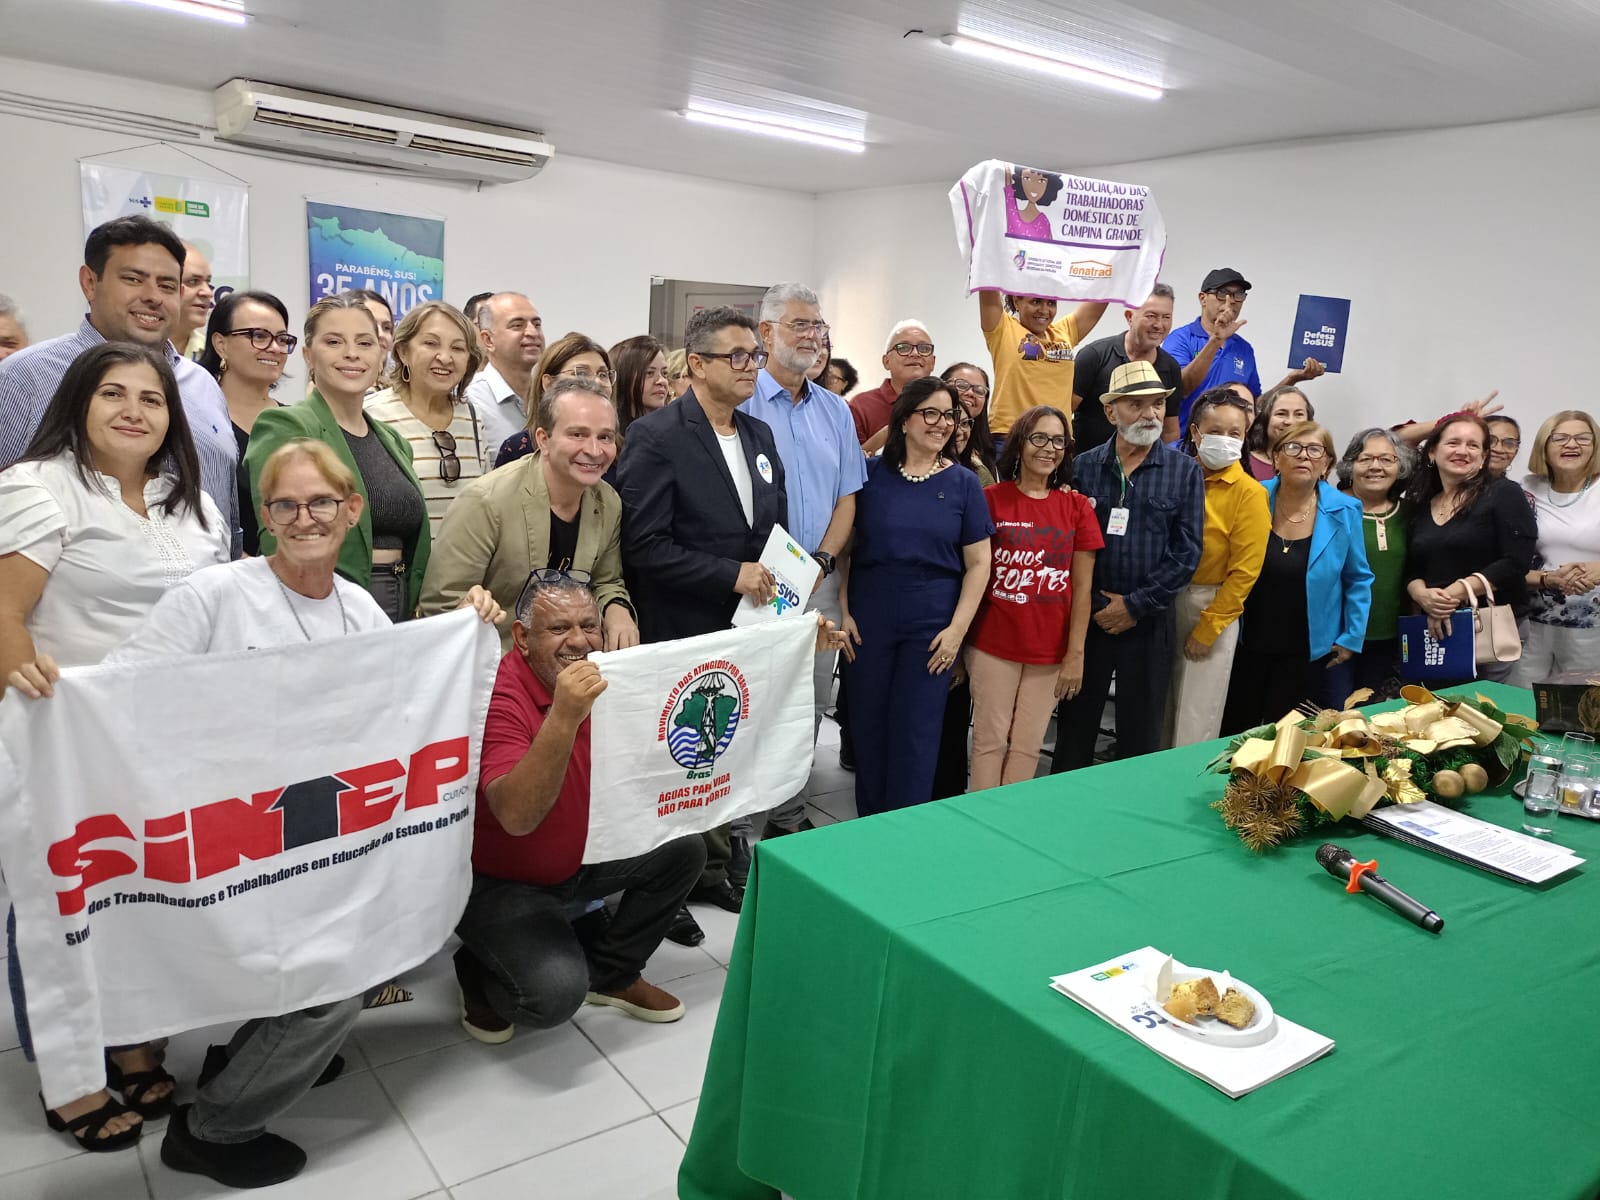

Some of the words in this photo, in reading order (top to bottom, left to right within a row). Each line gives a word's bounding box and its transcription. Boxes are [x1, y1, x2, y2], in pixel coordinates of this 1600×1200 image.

[1129, 186, 1148, 197] DAS
[1066, 192, 1145, 211] TRABALHADORAS
[1063, 208, 1125, 226] DOMÉSTICAS
[1126, 214, 1139, 226] DE
[1061, 224, 1102, 240] CAMPINA
[1105, 228, 1144, 241] GRANDE
[335, 263, 393, 279] PARABÉNS,
[394, 270, 417, 280] SUS!
[1069, 264, 1113, 277] fenatrad
[1304, 331, 1335, 340] Defesa
[1321, 325, 1336, 334] Em
[1303, 338, 1334, 347] DoSUS
[994, 547, 1045, 568] SOMOS
[993, 566, 1070, 594] FORTES
[1438, 647, 1446, 665] Em
[657, 687, 680, 742] MOVIMENTO
[677, 672, 694, 689] DOS
[713, 772, 731, 788] VIDA
[657, 802, 676, 818] NÃO
[677, 797, 703, 811] PARA
[88, 896, 111, 915] dos
[114, 891, 217, 908] Trabalhadores
[217, 890, 226, 901] e
[226, 862, 309, 898] Trabalhadoras
[311, 857, 330, 871] em
[332, 834, 381, 865] Educação
[381, 831, 394, 845] do
[396, 820, 434, 840] Estado
[435, 816, 449, 830] da
